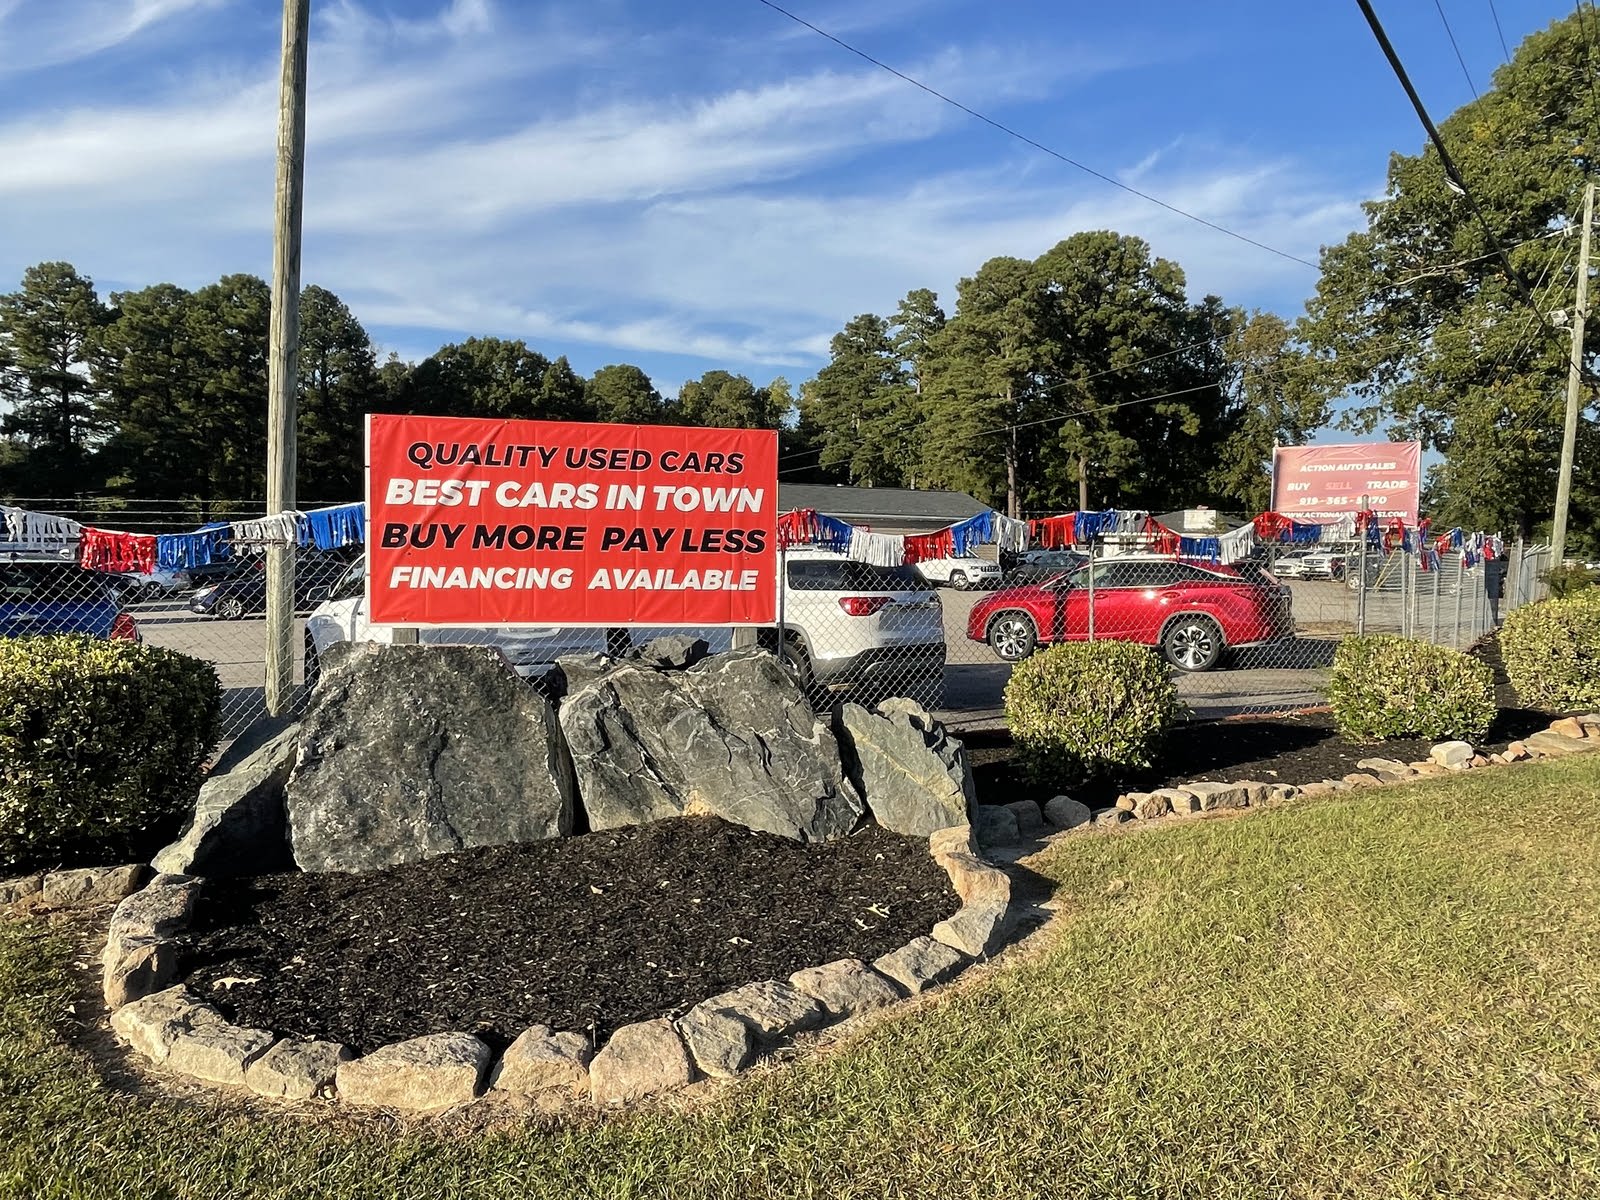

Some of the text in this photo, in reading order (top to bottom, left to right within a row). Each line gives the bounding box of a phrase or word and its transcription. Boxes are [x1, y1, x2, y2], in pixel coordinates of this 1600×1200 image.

[407, 441, 744, 474] QUALITY USED CARS
[1300, 462, 1396, 472] ACTION AUTO SALES
[385, 477, 764, 514] BEST CARS IN TOWN
[1287, 480, 1408, 491] BUY SELL TRADE
[381, 523, 767, 554] BUY MORE PAY LESS
[389, 566, 759, 592] FINANCING AVAILABLE
